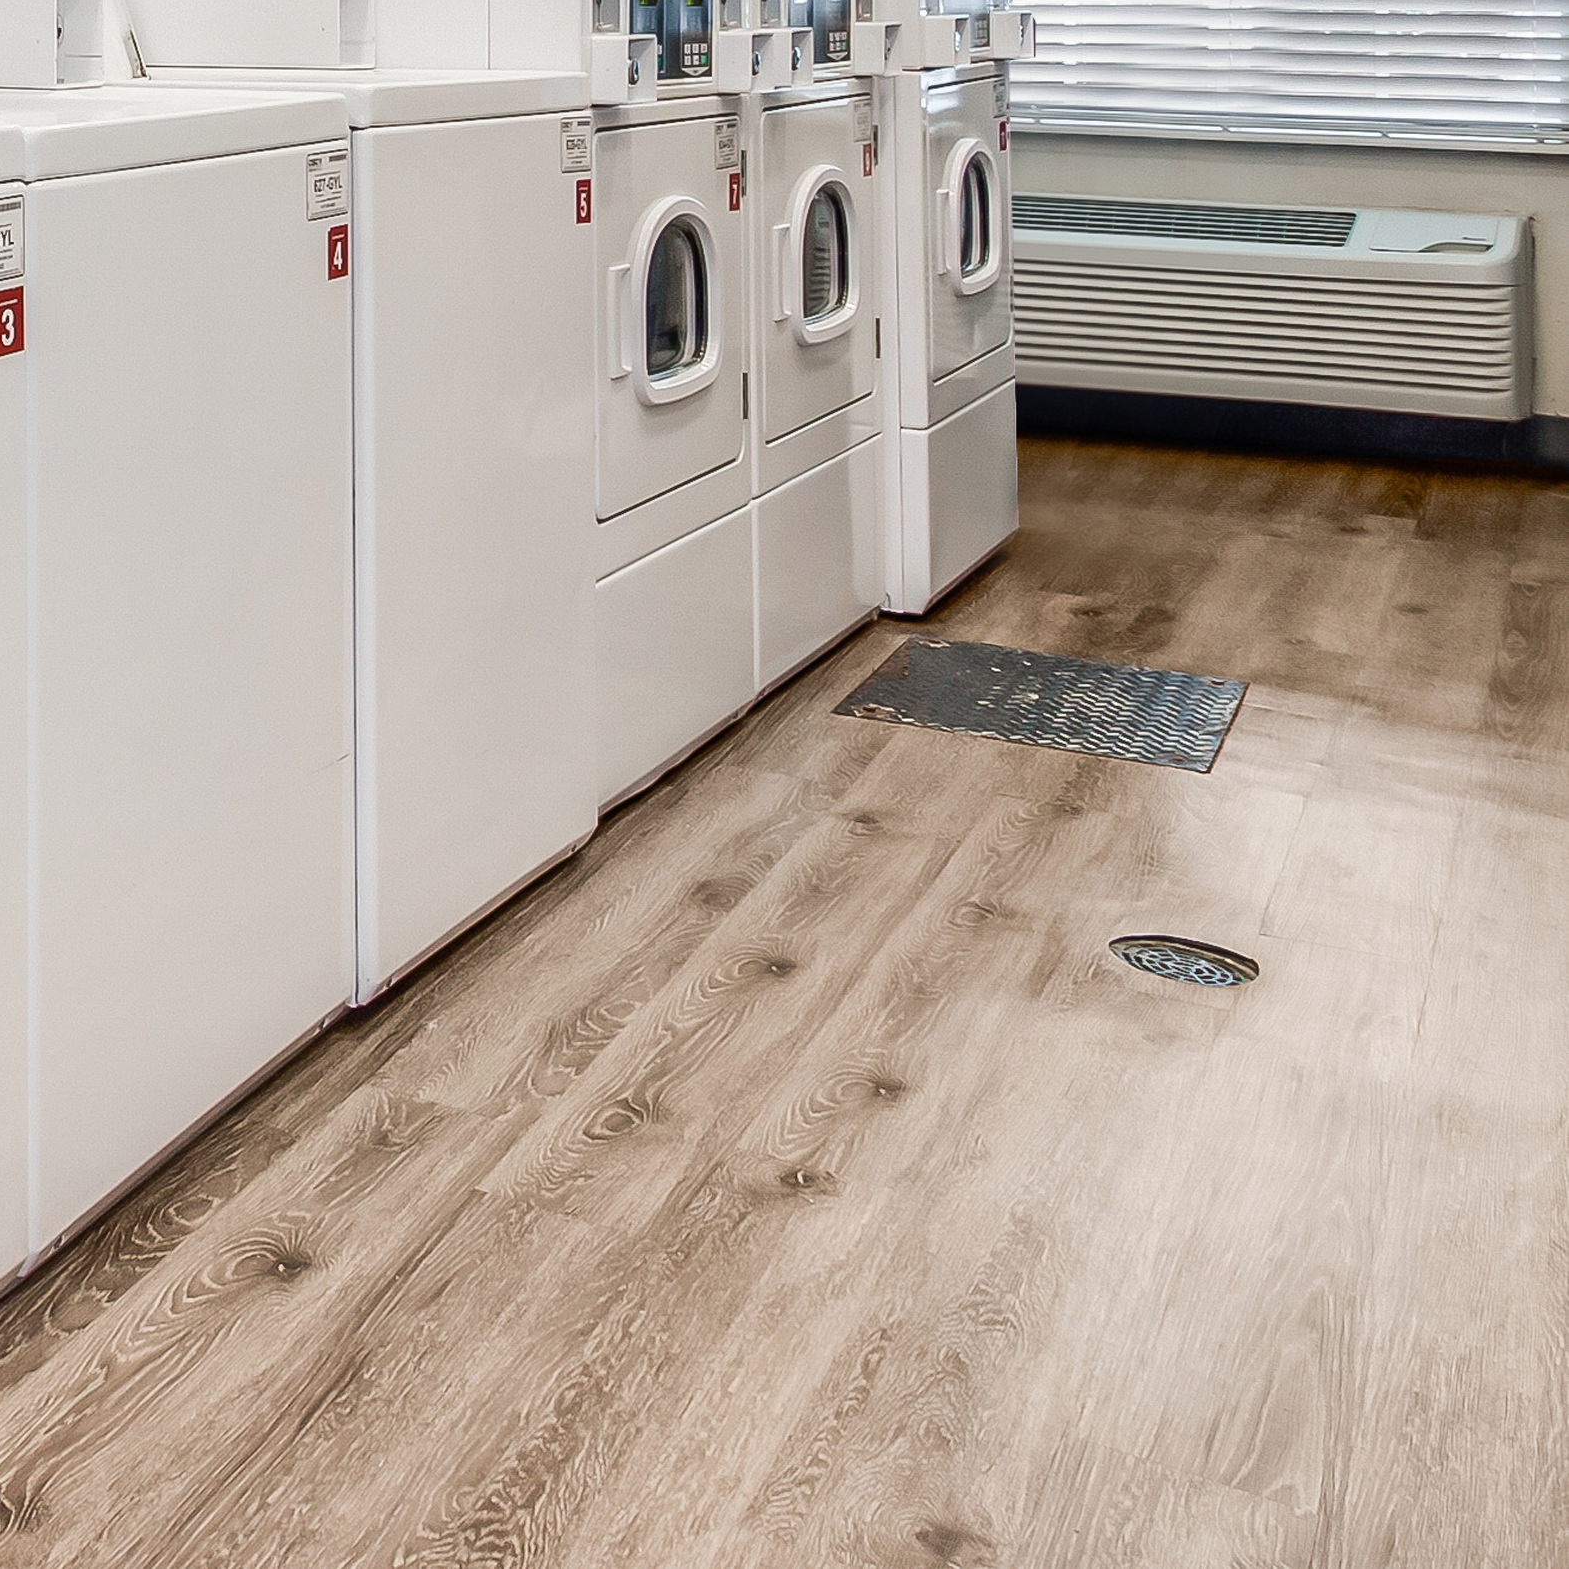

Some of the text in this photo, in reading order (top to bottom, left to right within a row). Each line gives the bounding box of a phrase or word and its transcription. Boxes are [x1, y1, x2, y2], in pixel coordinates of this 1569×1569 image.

[580, 192, 587, 218] 5
[333, 241, 343, 270] 4
[1, 308, 15, 347] 3
